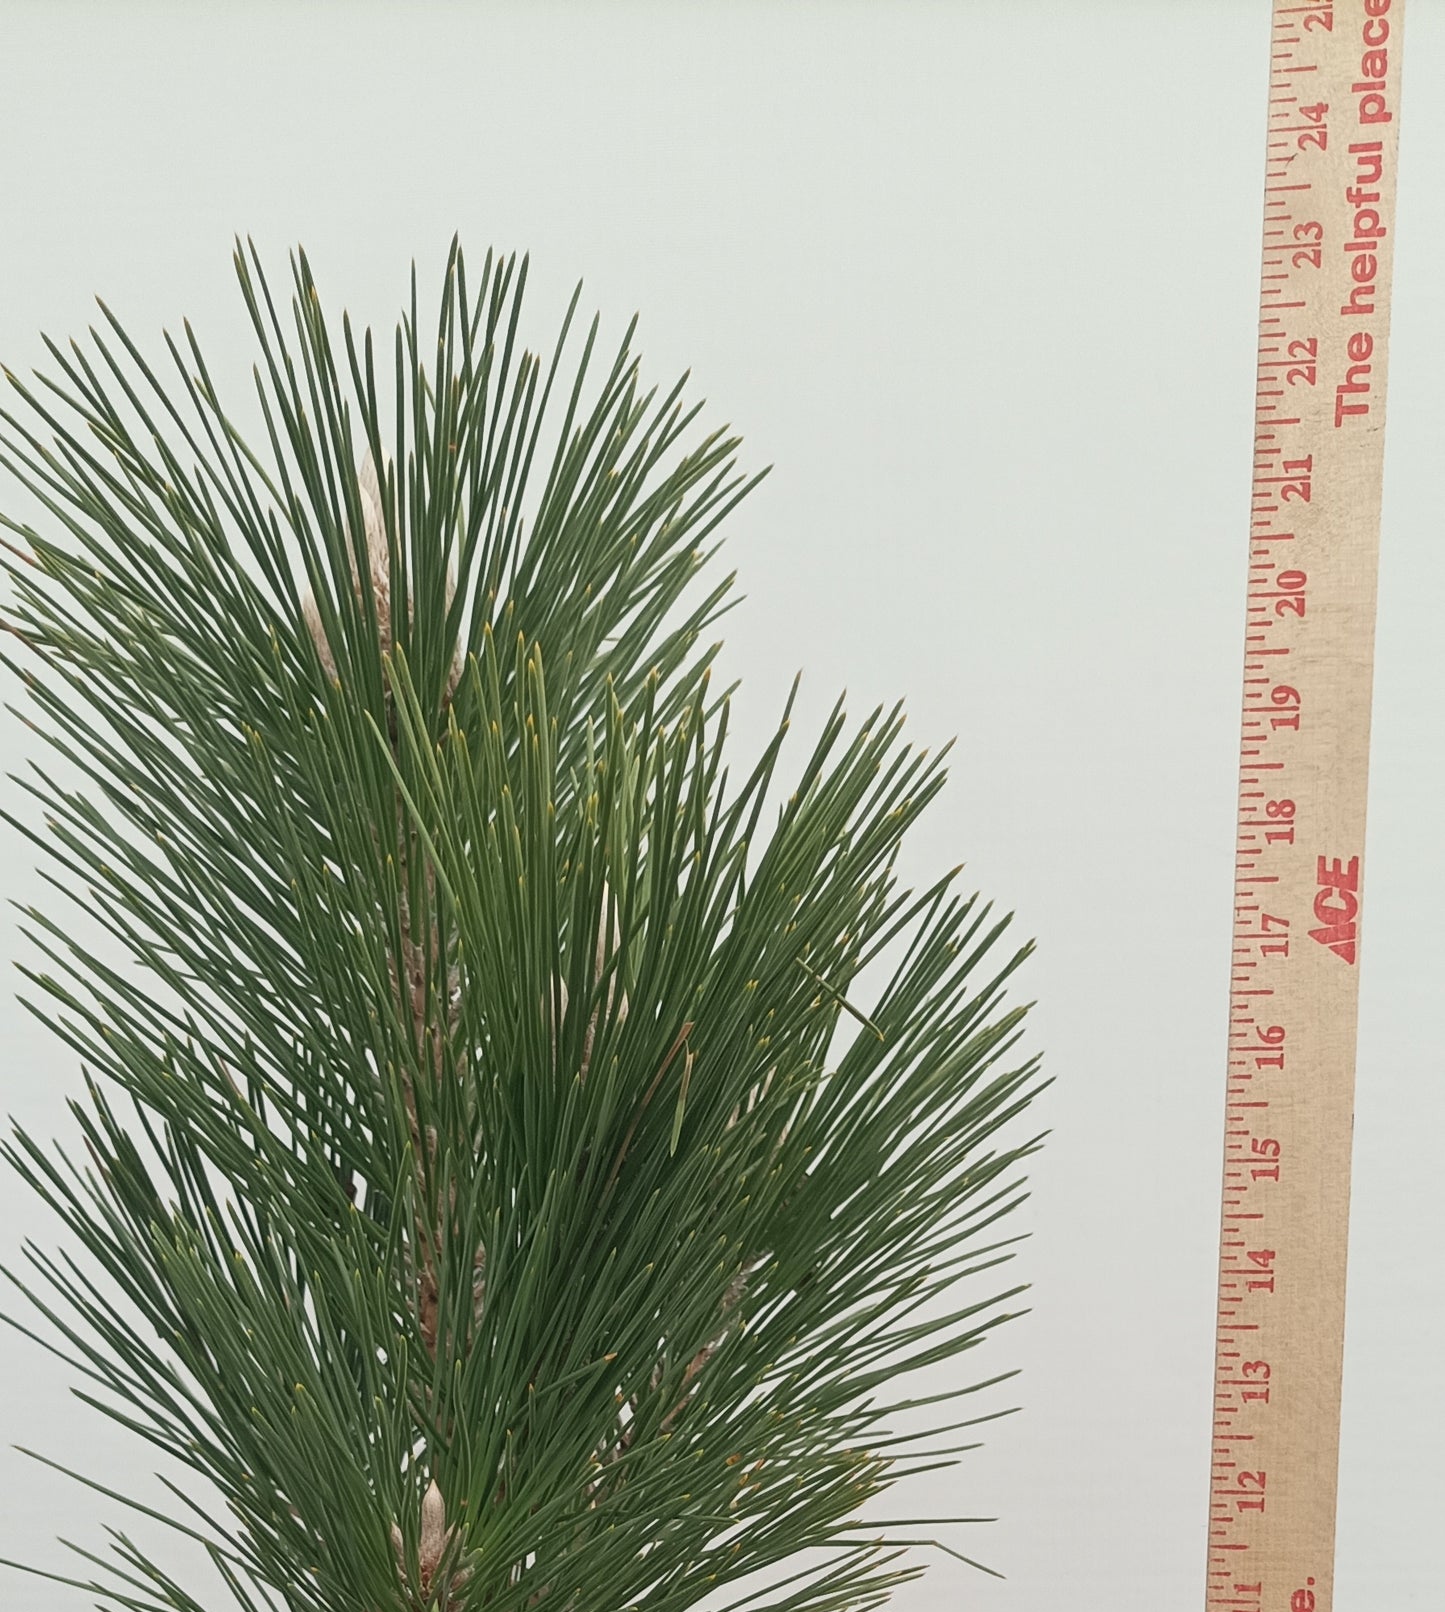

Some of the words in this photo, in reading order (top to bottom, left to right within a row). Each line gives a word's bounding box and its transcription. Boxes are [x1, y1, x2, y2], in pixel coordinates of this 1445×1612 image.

[1297, 102, 1329, 151] 24
[1291, 220, 1324, 269] 23
[1340, 141, 1387, 316] helpful
[1286, 337, 1318, 386] 22
[1334, 332, 1374, 428] The
[1281, 454, 1312, 502] 21
[1276, 569, 1308, 617] 20
[1270, 685, 1302, 731] 19
[1265, 799, 1296, 846] 18
[1308, 855, 1360, 965] ACE
[1261, 913, 1291, 958] 17
[1255, 1024, 1286, 1070] 16
[1251, 1138, 1281, 1183] 15
[1246, 1249, 1276, 1294] 14
[1242, 1360, 1272, 1405] 13
[1237, 1470, 1267, 1513] 12
